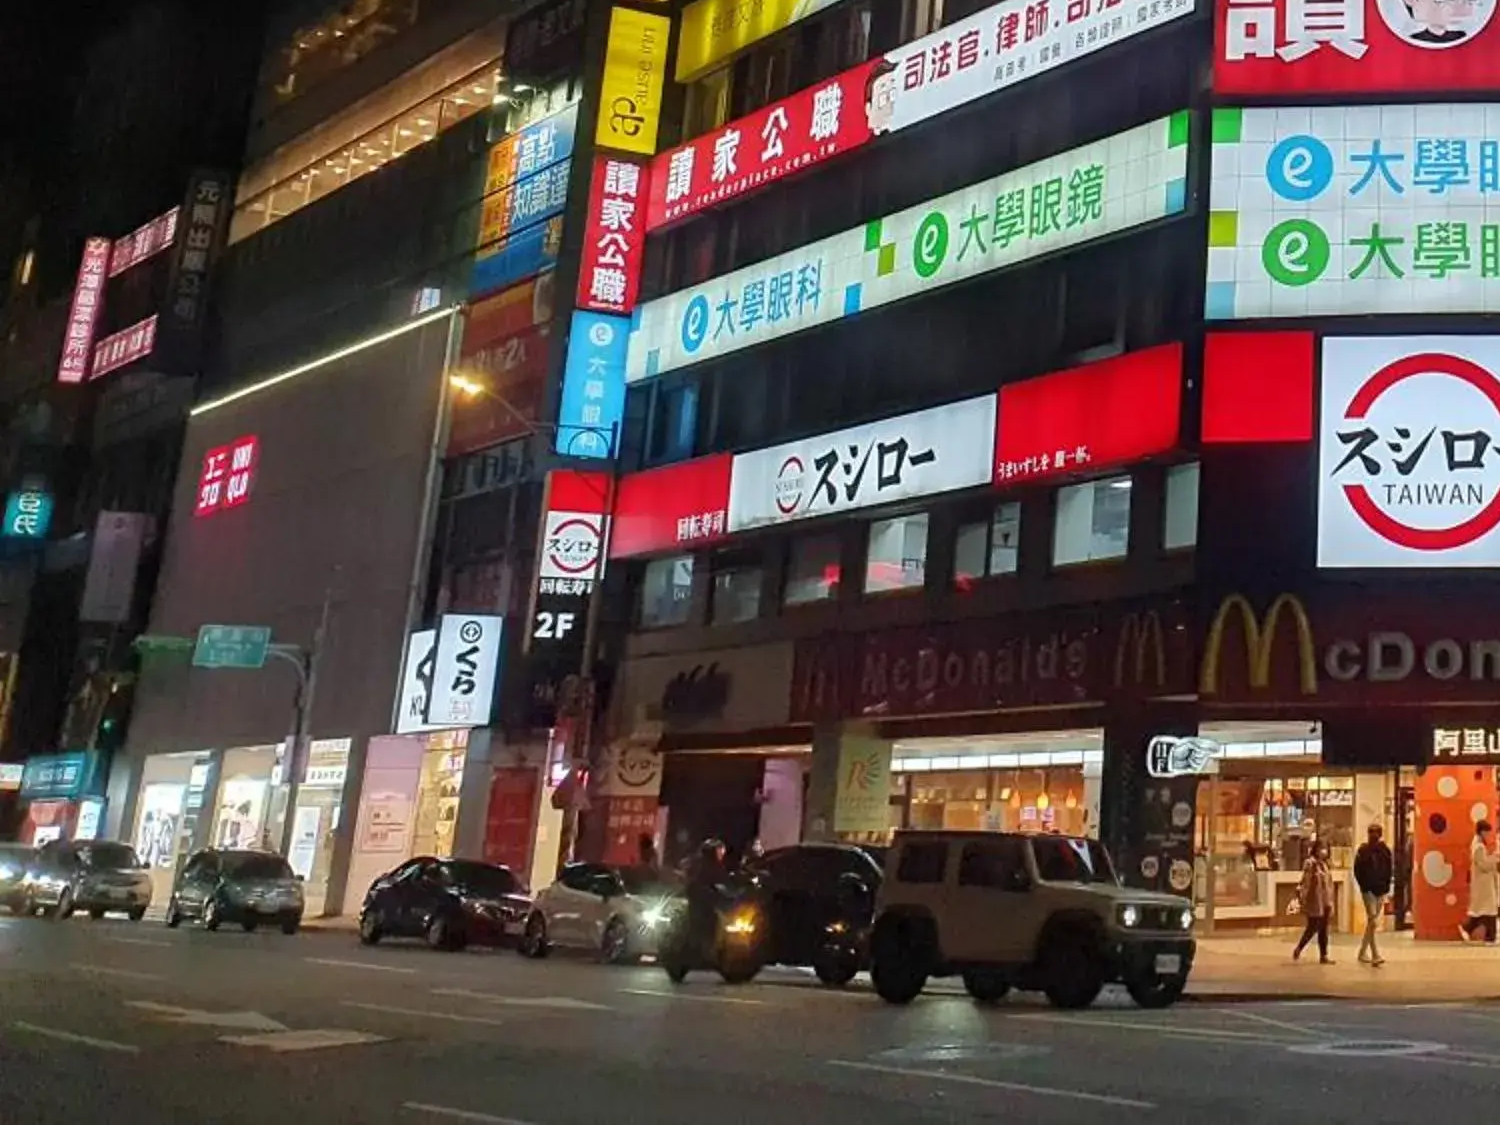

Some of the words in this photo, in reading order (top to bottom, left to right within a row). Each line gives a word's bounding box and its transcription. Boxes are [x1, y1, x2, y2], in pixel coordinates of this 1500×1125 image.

[665, 82, 842, 204] 讀家公職
[591, 160, 641, 305] 讀家公職
[956, 163, 1105, 263] 大學眼鏡
[712, 257, 824, 340] 大學眼科
[806, 437, 937, 510] スシロー
[1383, 483, 1484, 507] TAIWAN
[676, 511, 726, 542] 回転寿司
[534, 612, 575, 639] 2F
[451, 645, 480, 695] くら
[862, 630, 1089, 697] McDonald's
